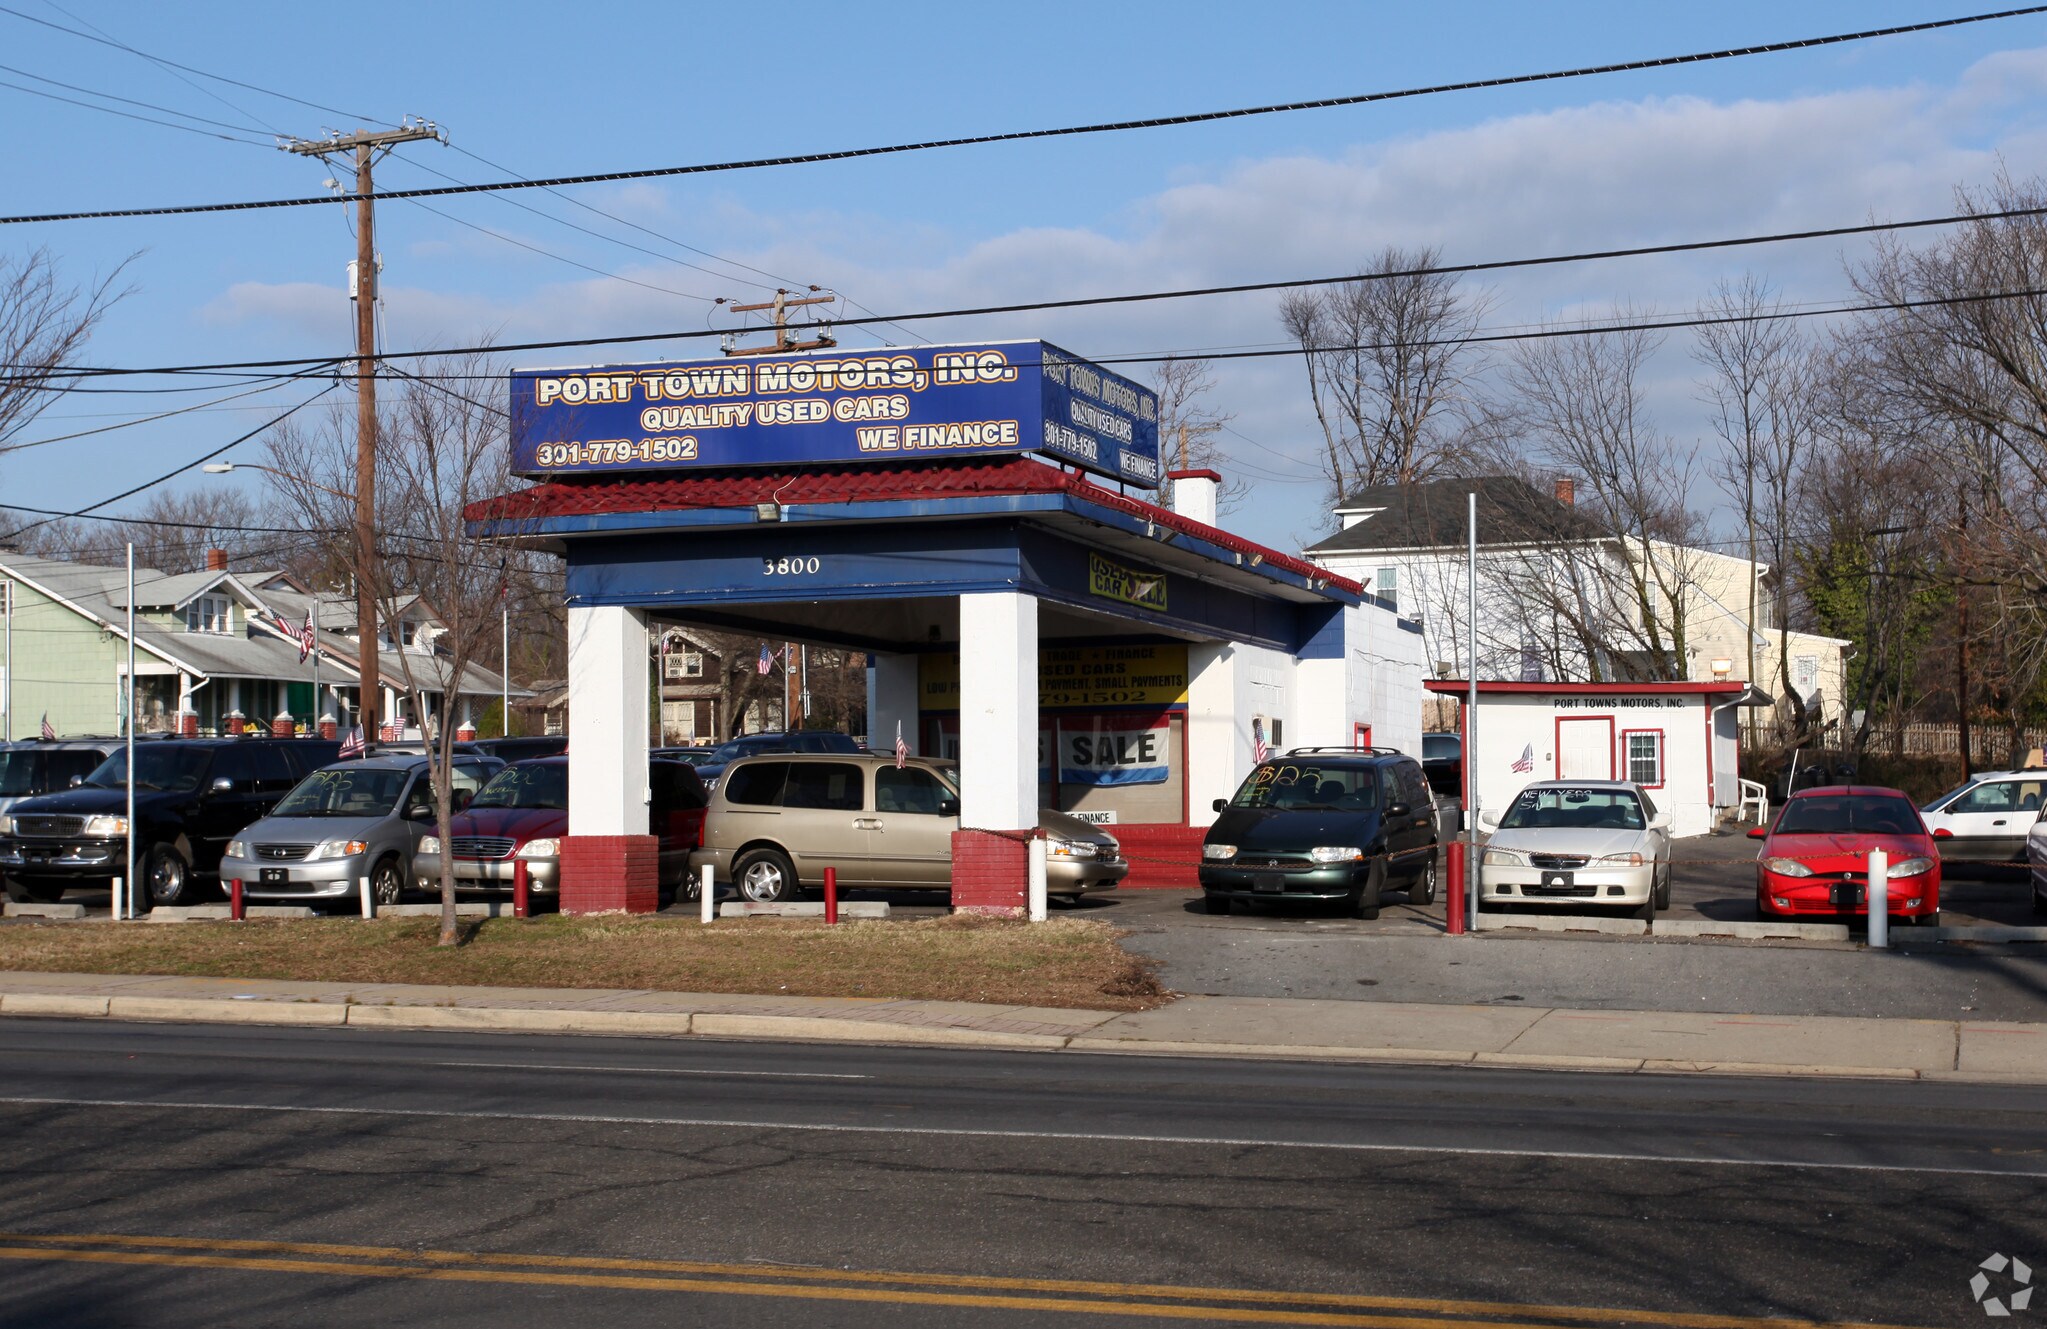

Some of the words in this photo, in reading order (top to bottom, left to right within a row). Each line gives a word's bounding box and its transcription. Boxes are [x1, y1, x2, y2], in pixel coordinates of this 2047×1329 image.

[538, 375, 635, 404] PORT
[642, 367, 749, 400] TOWN
[757, 358, 927, 391] MOTORS,
[936, 353, 1016, 383] INC.
[642, 404, 751, 430] QUALITY
[757, 399, 830, 425] USED
[835, 396, 908, 421] CARS
[1102, 378, 1140, 420] MOTORS,
[1071, 401, 1097, 428] QUALITY
[1097, 412, 1115, 434] USED
[1115, 418, 1132, 441] CARS
[858, 427, 899, 450] WE
[905, 422, 1017, 448] FINANCE
[1045, 422, 1098, 460] 301-779-1502
[538, 437, 697, 465] 301-779-1502
[1120, 451, 1131, 469] WE
[1131, 454, 1157, 479] FINANCE
[763, 557, 820, 576] 3800
[1105, 648, 1156, 660] FINANCE
[1082, 663, 1127, 676] CARS
[927, 682, 947, 694] LOW
[1095, 677, 1128, 689] SMALL
[1131, 675, 1183, 688] PAYMENTS
[1554, 698, 1580, 708] PORT
[1584, 698, 1617, 708] TOWNS
[1621, 698, 1663, 709] MOTORS,
[1667, 698, 1685, 708] INC.
[1073, 734, 1157, 766] SALE
[1520, 789, 1552, 799] NEW
